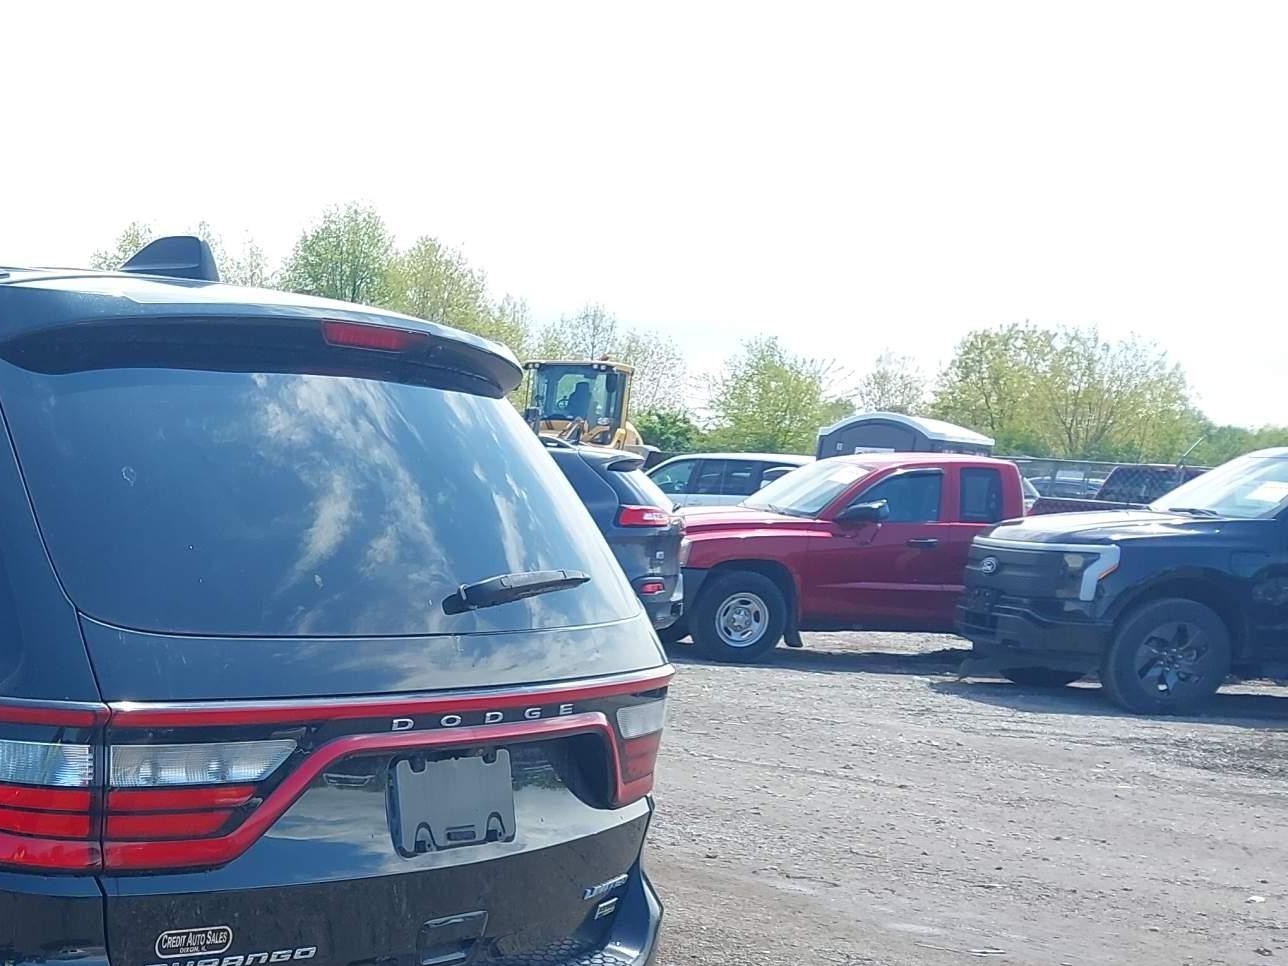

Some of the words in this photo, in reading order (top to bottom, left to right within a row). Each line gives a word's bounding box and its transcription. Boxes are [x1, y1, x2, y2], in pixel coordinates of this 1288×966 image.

[391, 703, 574, 731] DODGE
[161, 933, 187, 949] CREDIT
[186, 932, 206, 947] AUTO
[206, 930, 228, 944] SALES
